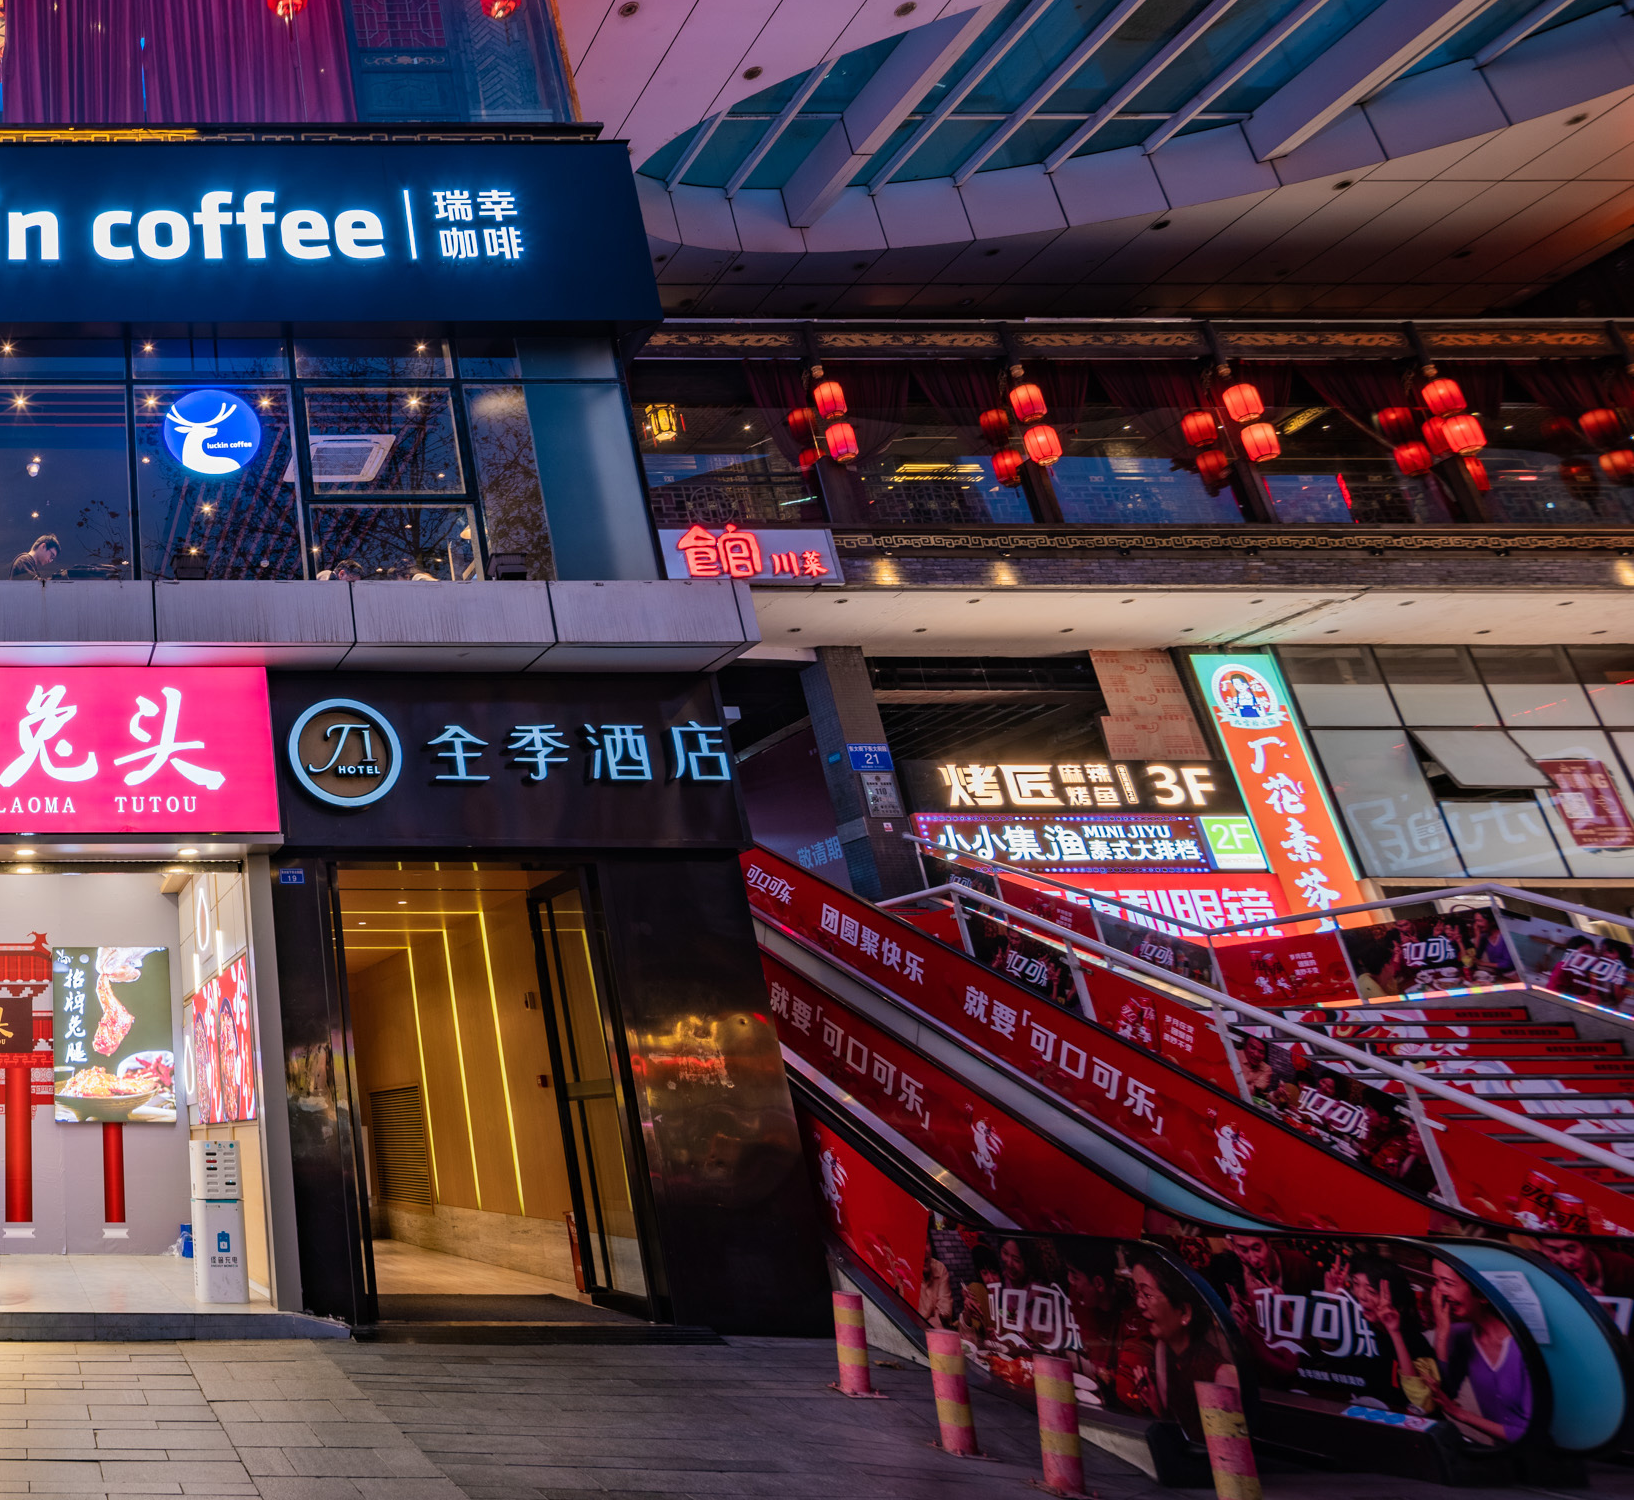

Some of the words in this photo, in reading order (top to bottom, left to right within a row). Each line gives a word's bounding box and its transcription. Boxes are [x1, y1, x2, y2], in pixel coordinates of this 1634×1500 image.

[433, 188, 516, 221] 瑞幸
[92, 189, 386, 261] coffee
[440, 227, 524, 260] 咖啡
[207, 441, 228, 450] luckin
[230, 440, 252, 449] coffee
[771, 550, 829, 577] 川菜
[427, 721, 732, 781] 全季酒店
[864, 752, 880, 765] 21
[337, 764, 381, 775] HOTEL
[1057, 763, 1114, 783] 麻辣
[874, 787, 888, 796] 110
[938, 764, 1065, 806] 烤匠
[1065, 786, 1122, 806] 烤鱼
[1146, 765, 1216, 806] 3F
[115, 795, 198, 814] TUTOU
[1082, 825, 1126, 839] MINI
[1126, 825, 1172, 839] JIYU
[1210, 822, 1252, 850] 2F
[797, 836, 844, 869] 敬请期
[1090, 839, 1200, 861] 泰式大排档
[746, 863, 796, 905] 可口可乐
[820, 902, 925, 985] 团圆聚快乐
[63, 968, 88, 1063] 招牌兔腿
[1253, 1287, 1381, 1358] 可口可乐
